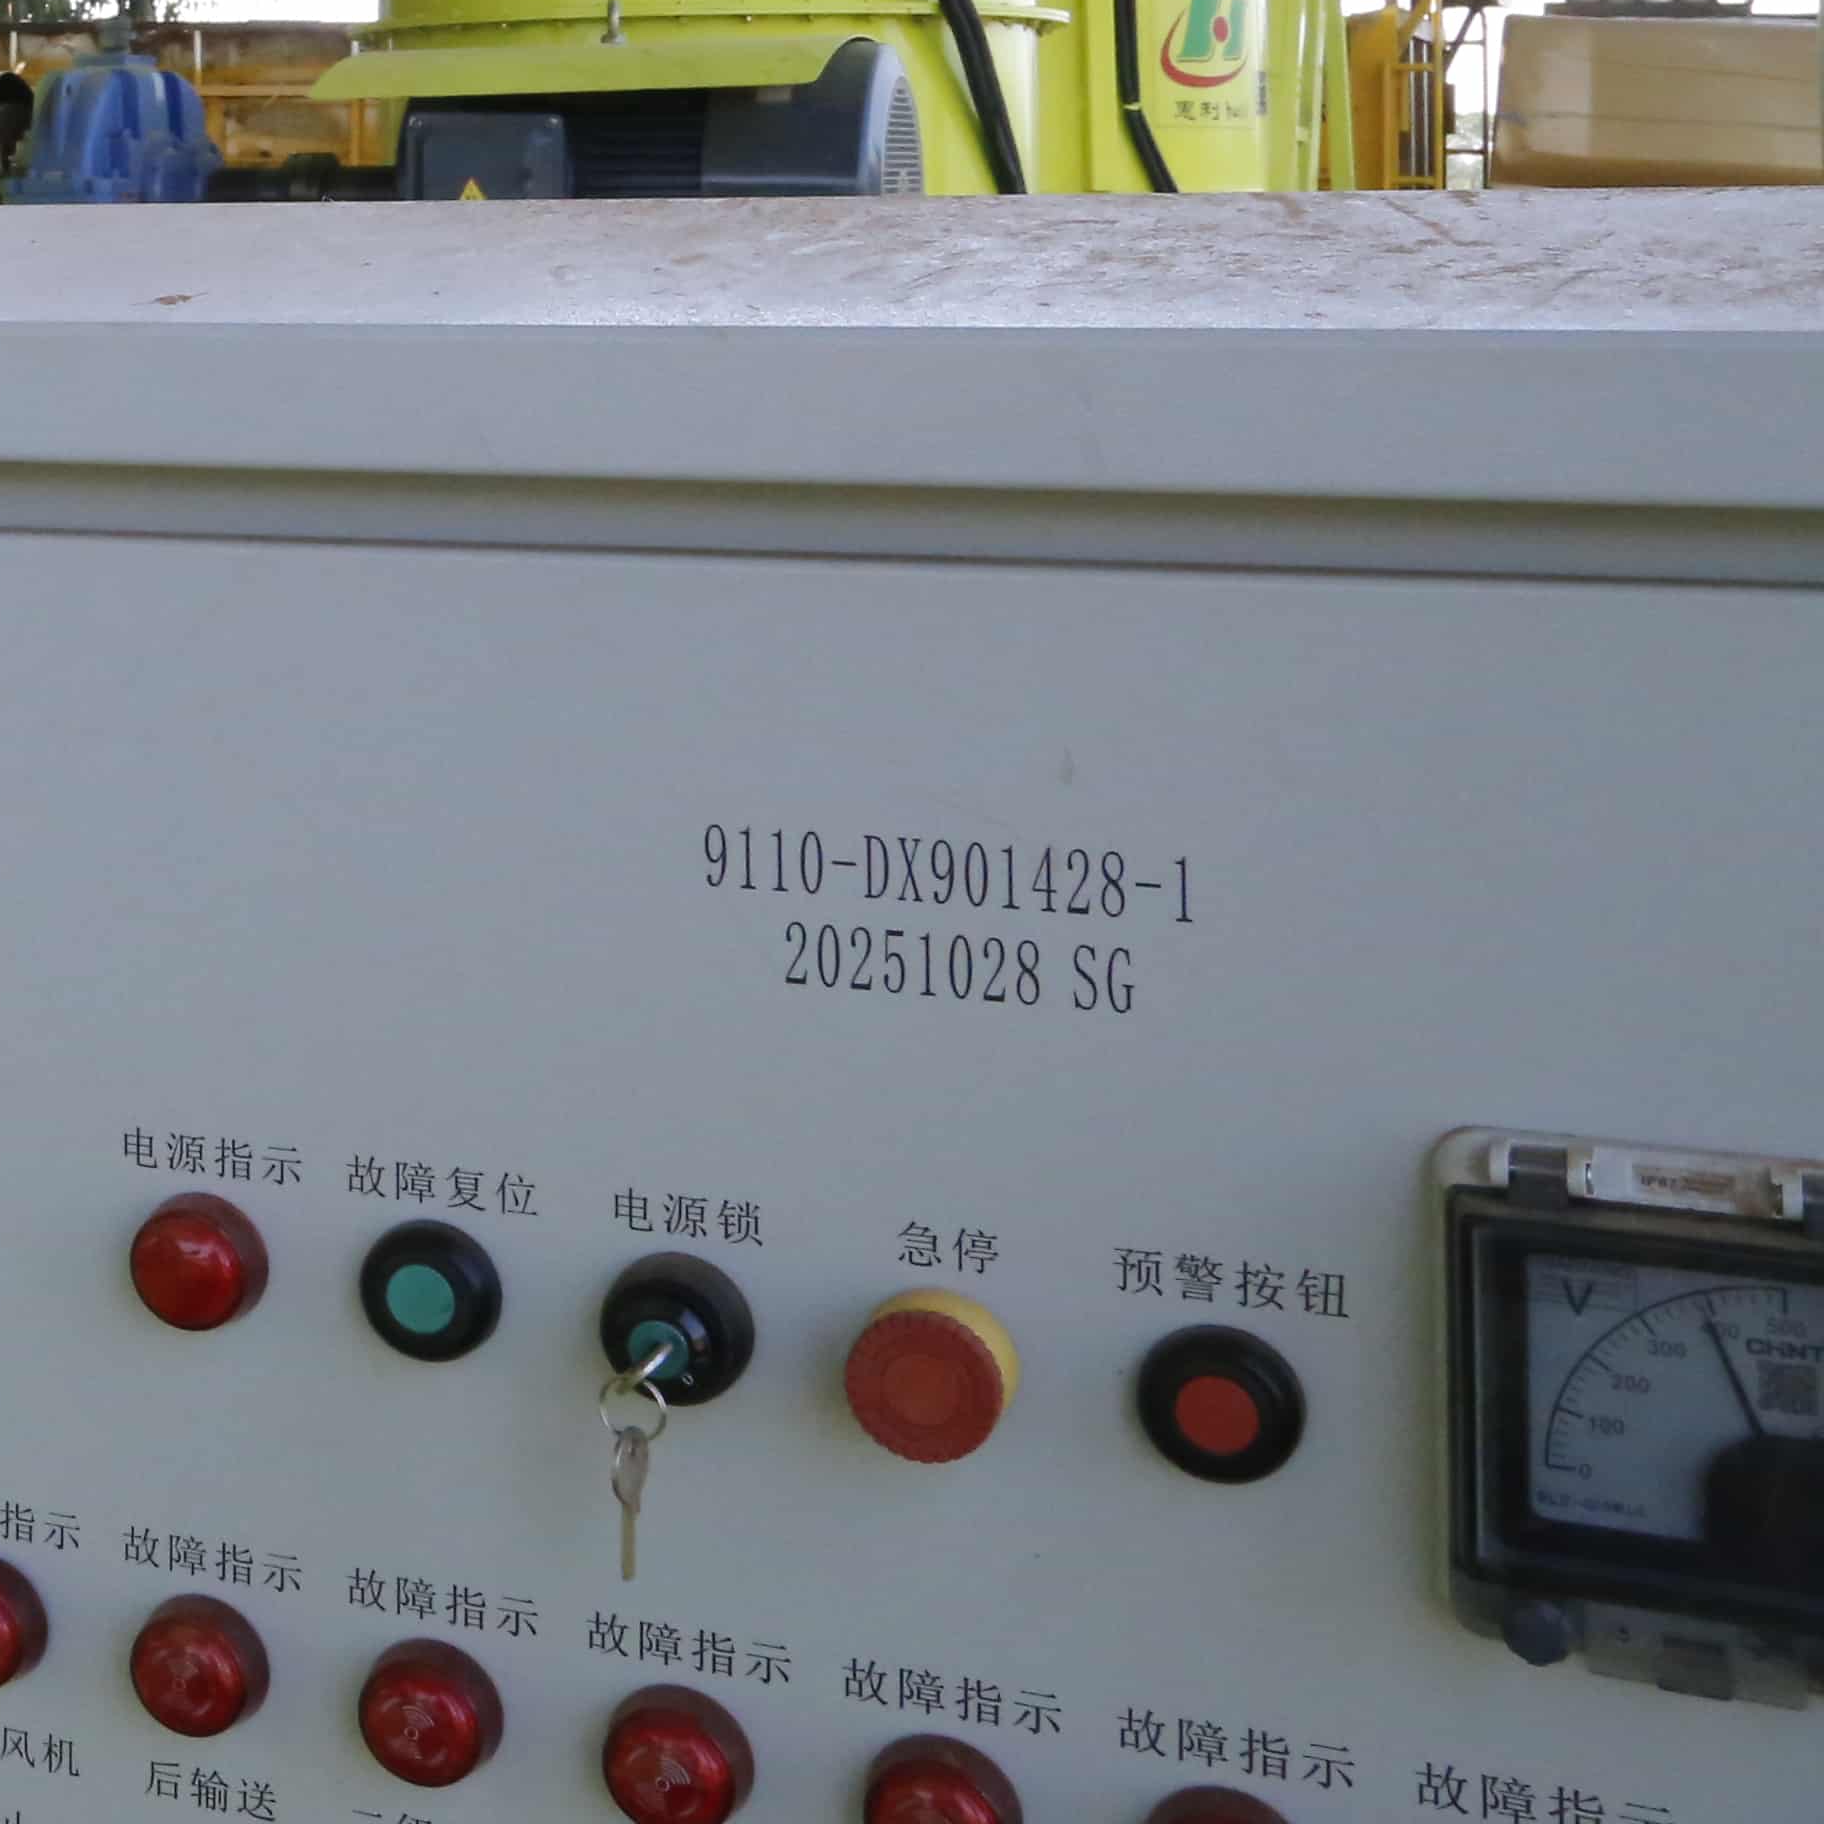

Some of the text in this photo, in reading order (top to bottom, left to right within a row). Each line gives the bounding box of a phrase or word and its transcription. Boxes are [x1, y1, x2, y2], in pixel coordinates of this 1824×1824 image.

[703, 823, 1194, 923] 9110-DX901428-1
[784, 921, 1135, 1014] 20251028 SG
[121, 1127, 304, 1187] 电源指示
[345, 1155, 540, 1217] 故障复位
[612, 1188, 765, 1248] 电源锁
[897, 1220, 1000, 1275] 急停
[1112, 1245, 1350, 1318] 预警按钮
[1562, 1278, 1595, 1316] V
[1611, 1374, 1651, 1395] 200
[1589, 1415, 1625, 1436] 100
[1578, 1462, 1593, 1480] 0
[122, 1526, 303, 1594] 故障指示
[345, 1567, 540, 1637] 故障指示
[586, 1611, 792, 1684] 故障指示
[840, 1657, 1063, 1736] 故障指示
[1116, 1706, 1355, 1790] 故障指示
[144, 1760, 278, 1824] 后输送
